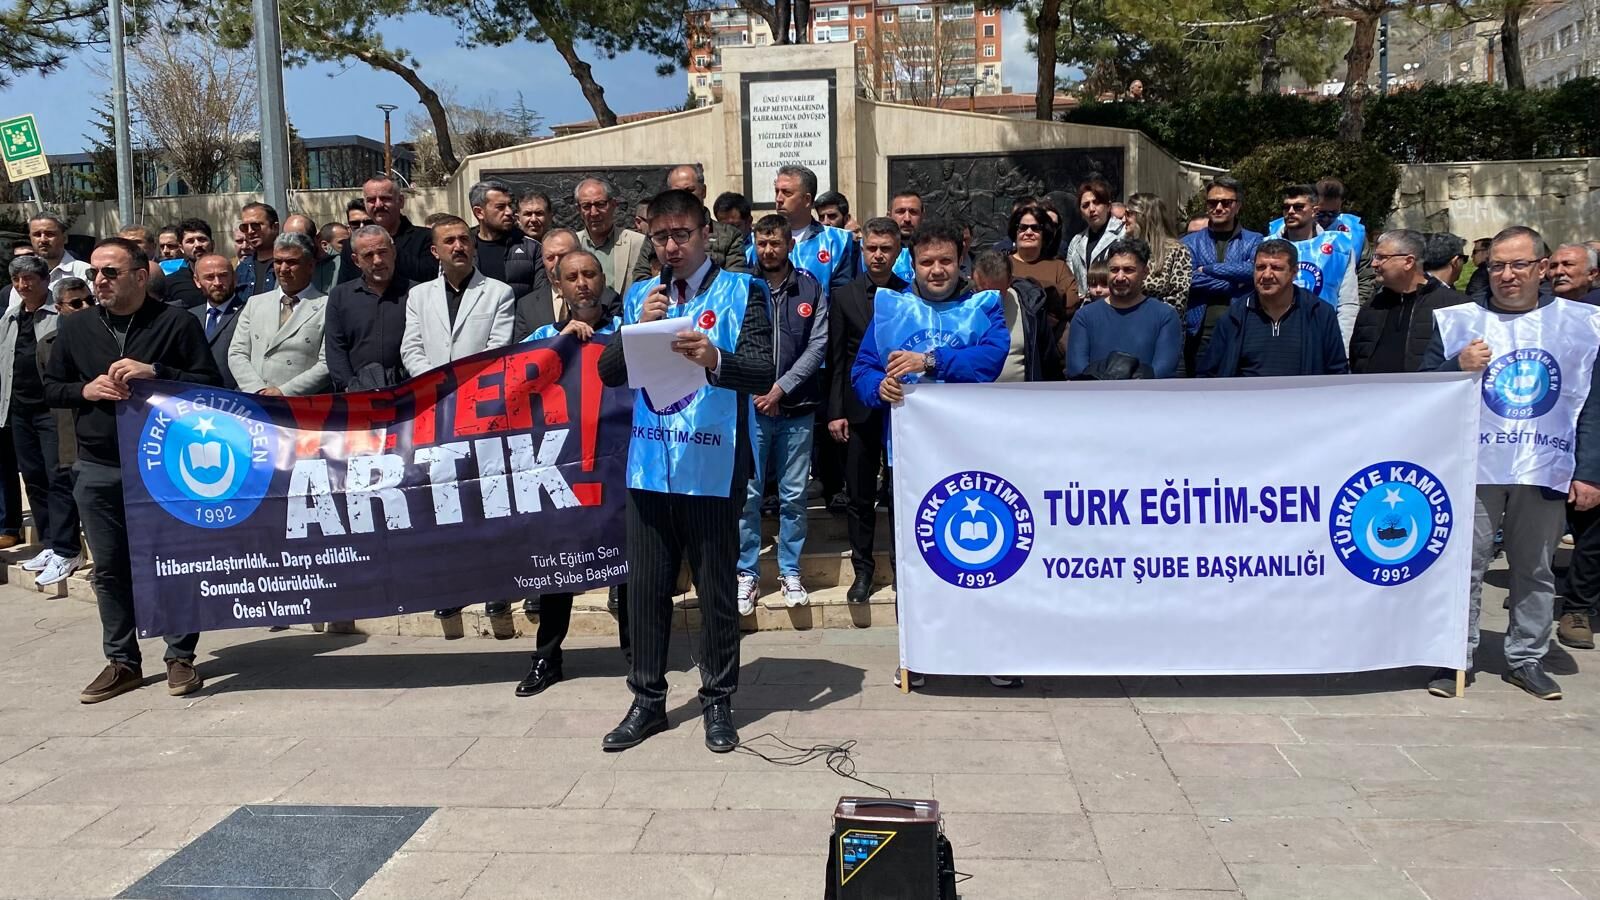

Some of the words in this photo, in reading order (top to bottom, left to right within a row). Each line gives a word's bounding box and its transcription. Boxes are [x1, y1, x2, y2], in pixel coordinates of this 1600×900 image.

[752, 114, 796, 122] KAHRAMANCA
[753, 105, 770, 113] HARP
[771, 104, 825, 112] MEYDANLARINDA
[766, 141, 792, 149] OLDUĞU
[794, 131, 821, 139] HARMAN
[1506, 407, 1535, 417] 1992
[142, 411, 172, 471] TÜRK
[175, 393, 269, 463] EĞİTİM-SEN
[647, 425, 722, 446] EĞİTİM-SEN
[916, 493, 946, 552] TÜRK
[944, 473, 1033, 551] EĞİTİM-SEN
[1043, 481, 1131, 526] TÜRK
[1140, 477, 1321, 525] EĞİTİM-SEN
[195, 505, 237, 523] 1992
[1333, 470, 1384, 560] TÜRKİYE
[1390, 466, 1450, 555] KAMU-SEN
[281, 551, 313, 570] Darp
[314, 546, 371, 566] edildik...
[530, 554, 558, 568] Türk
[559, 551, 595, 567] Eğitim
[597, 546, 620, 560] Sen
[1042, 557, 1126, 579] YOZGAT
[1133, 556, 1190, 584] ŞUBE
[1196, 550, 1325, 583] BAŞKANLIĞI
[513, 574, 552, 589] Yozgat
[554, 571, 583, 587] Şube
[585, 560, 629, 581] Başkanl
[957, 571, 997, 587] 1992
[1372, 565, 1411, 582] 1992
[200, 577, 255, 597] Sonunda
[257, 573, 337, 593] Oldürüldük...
[232, 598, 266, 619] Ötesi
[270, 597, 312, 617] Varmı?
